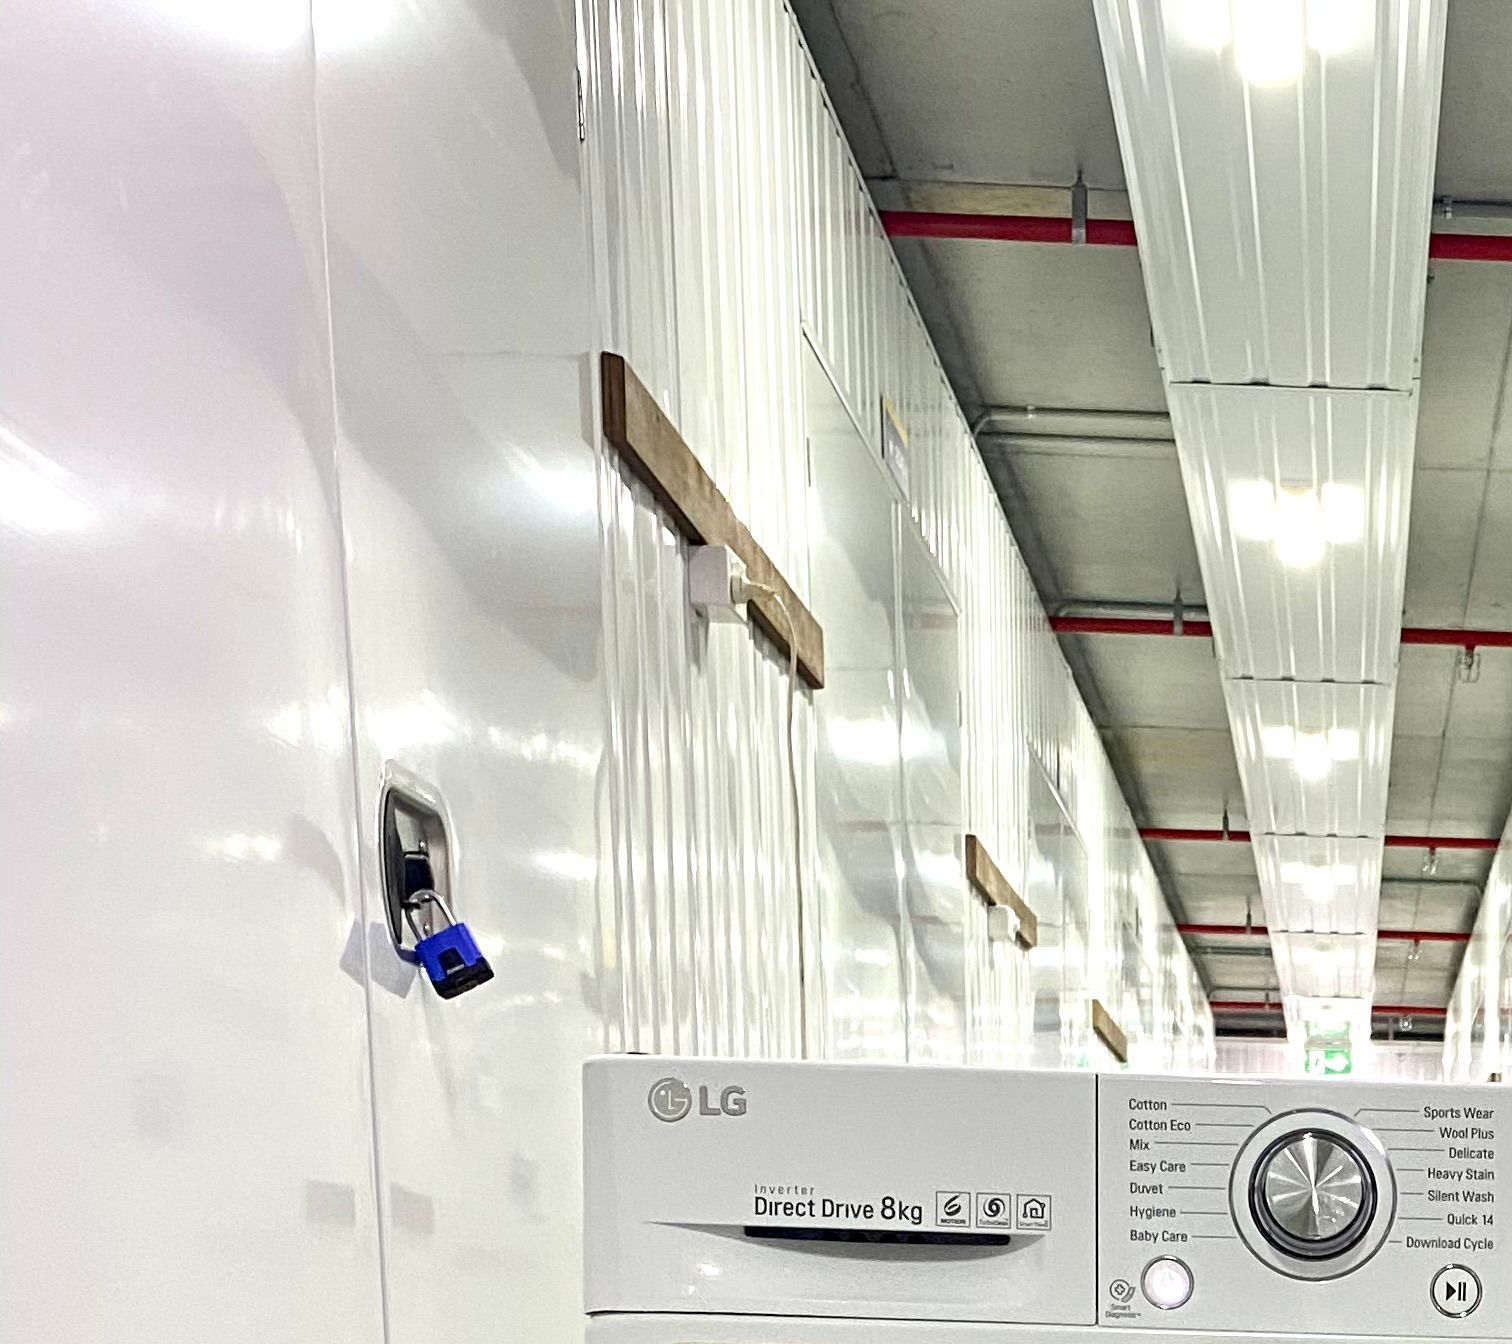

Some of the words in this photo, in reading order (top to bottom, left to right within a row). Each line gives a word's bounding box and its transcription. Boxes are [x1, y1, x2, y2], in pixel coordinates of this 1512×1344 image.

[699, 1086, 747, 1116] LG
[1129, 1098, 1167, 1110] Cotton
[1424, 1106, 1461, 1120] Sports
[1464, 1107, 1495, 1119] Wear
[1129, 1119, 1167, 1130] Cotton
[1170, 1119, 1191, 1131] Eco
[1440, 1127, 1468, 1139] Wool
[1471, 1128, 1495, 1139] Plus
[1130, 1139, 1150, 1150] Mix
[1449, 1147, 1495, 1159] Delicate
[1130, 1160, 1157, 1174] Easy
[1160, 1160, 1186, 1173] Care
[1427, 1167, 1463, 1182] Heavy
[1465, 1168, 1495, 1180] Stain
[754, 1184, 815, 1195] Inverter
[1130, 1182, 1163, 1194] Duvet
[1428, 1190, 1459, 1202] Silent
[1462, 1190, 1495, 1202] Wash
[754, 1196, 816, 1217] Direct
[822, 1198, 874, 1219] Drive
[880, 1196, 923, 1225] 8kg
[1130, 1205, 1176, 1220] Hygiene
[1447, 1214, 1478, 1226] Quick
[1482, 1214, 1494, 1226] 14
[1130, 1229, 1158, 1244] Baby
[1162, 1230, 1188, 1242] Care
[1406, 1236, 1461, 1249] Download
[1463, 1237, 1494, 1251] Cycle
